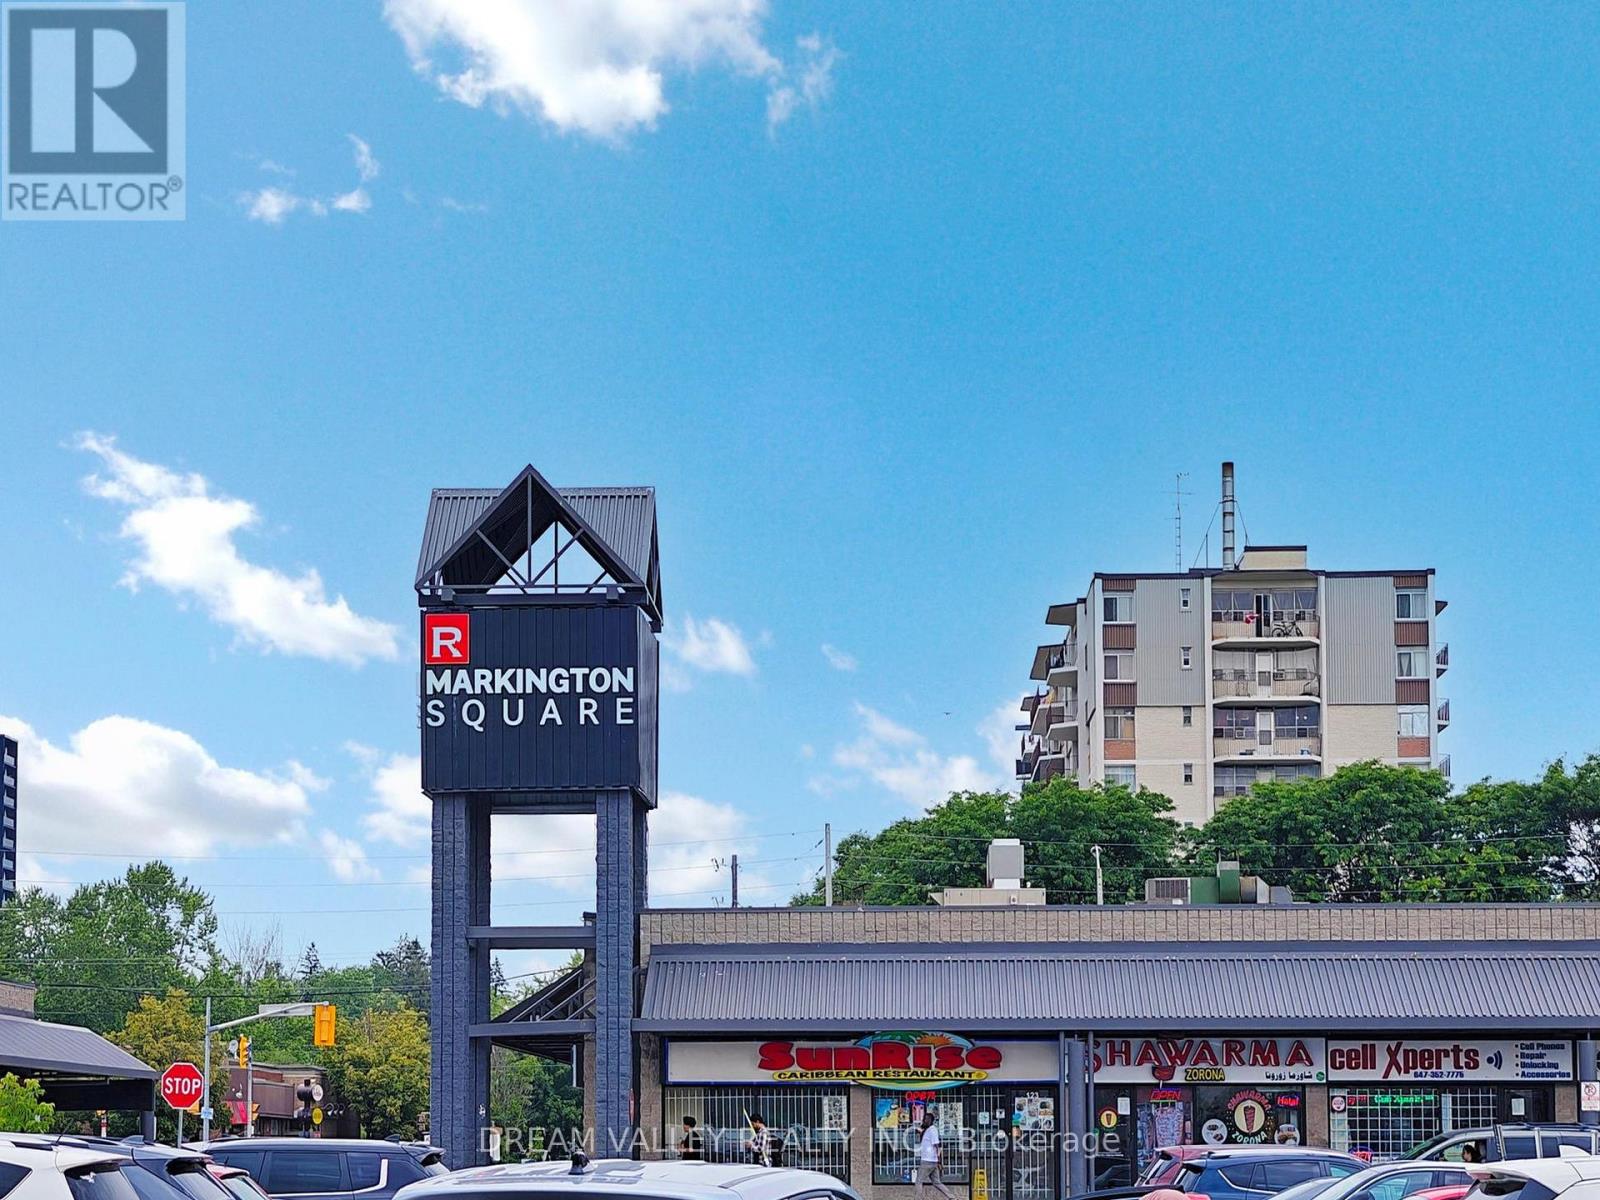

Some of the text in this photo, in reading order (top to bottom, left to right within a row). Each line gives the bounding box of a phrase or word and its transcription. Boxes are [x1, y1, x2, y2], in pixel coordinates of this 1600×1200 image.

[431, 627, 463, 658] R
[425, 667, 635, 695] MARKINGTON
[425, 697, 634, 732] SQUARE
[1329, 1042, 1480, 1079] cell Xperts
[1520, 1061, 1559, 1070] Unlocking
[164, 1077, 201, 1095] STOP
[777, 1070, 974, 1080] CARIBBEAN RESTAURANT
[1185, 1069, 1225, 1080] ZORONA
